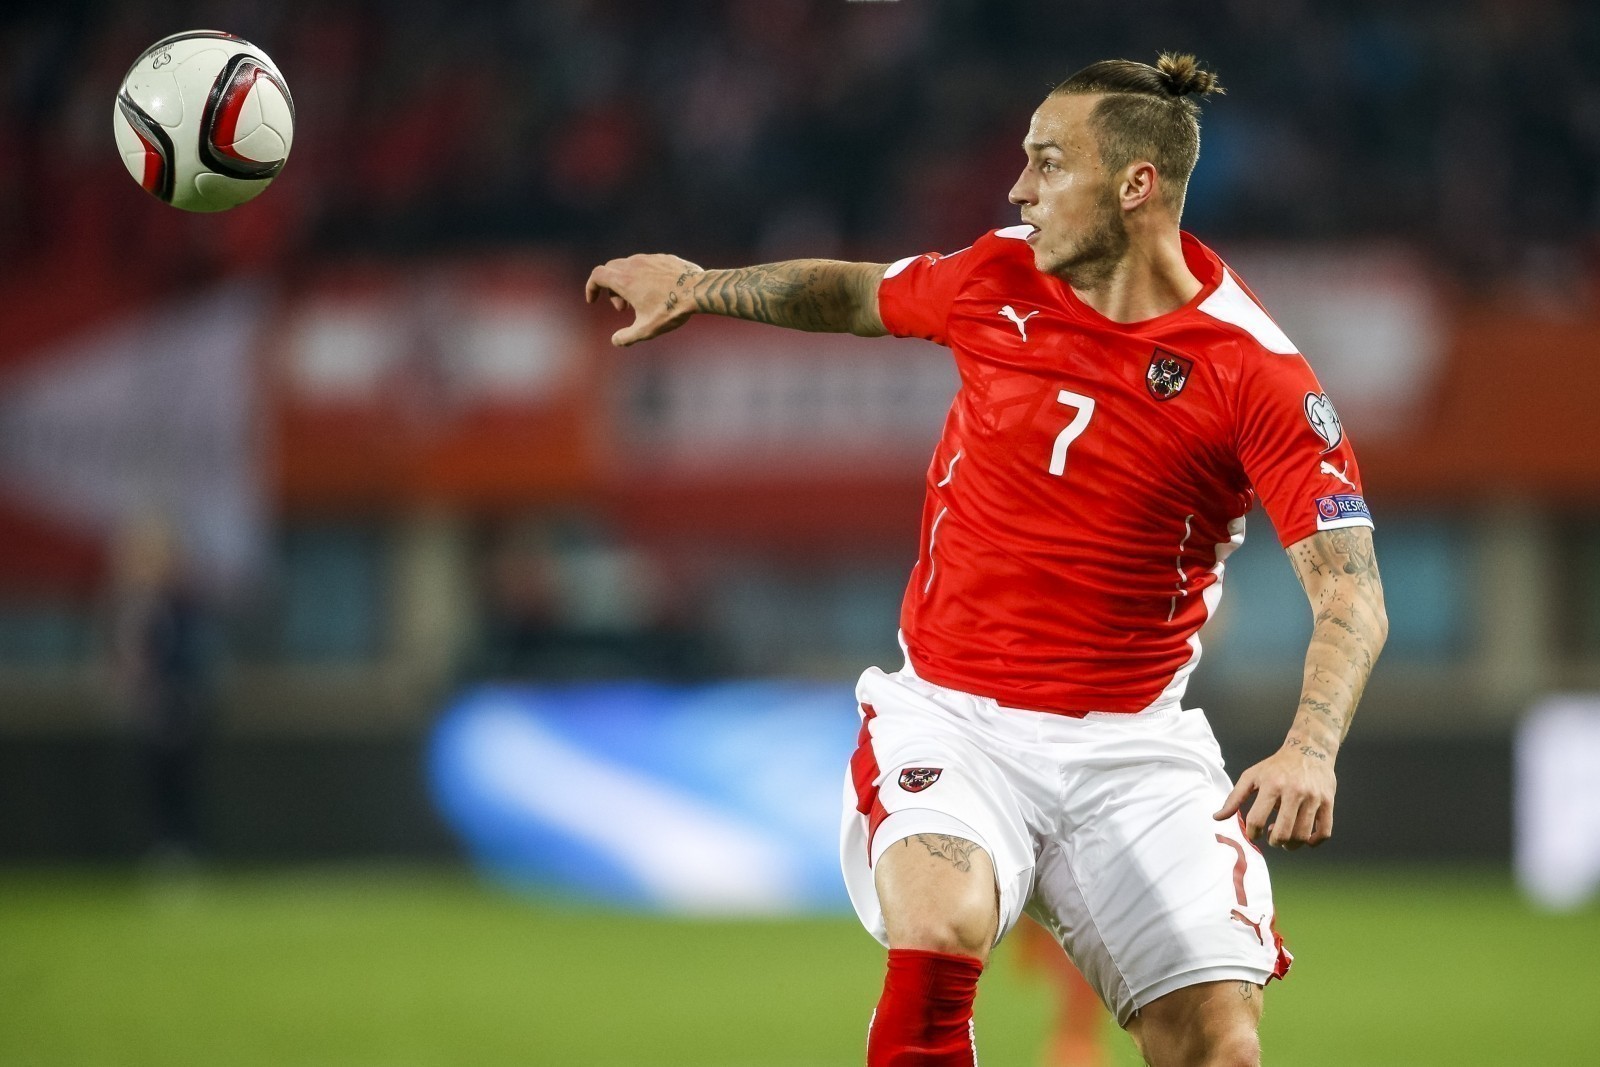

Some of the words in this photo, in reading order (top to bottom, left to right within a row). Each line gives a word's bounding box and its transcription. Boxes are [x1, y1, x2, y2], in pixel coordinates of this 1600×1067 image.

[1049, 389, 1095, 476] 7
[1338, 500, 1368, 513] RESPE
[1215, 833, 1248, 907] 7
